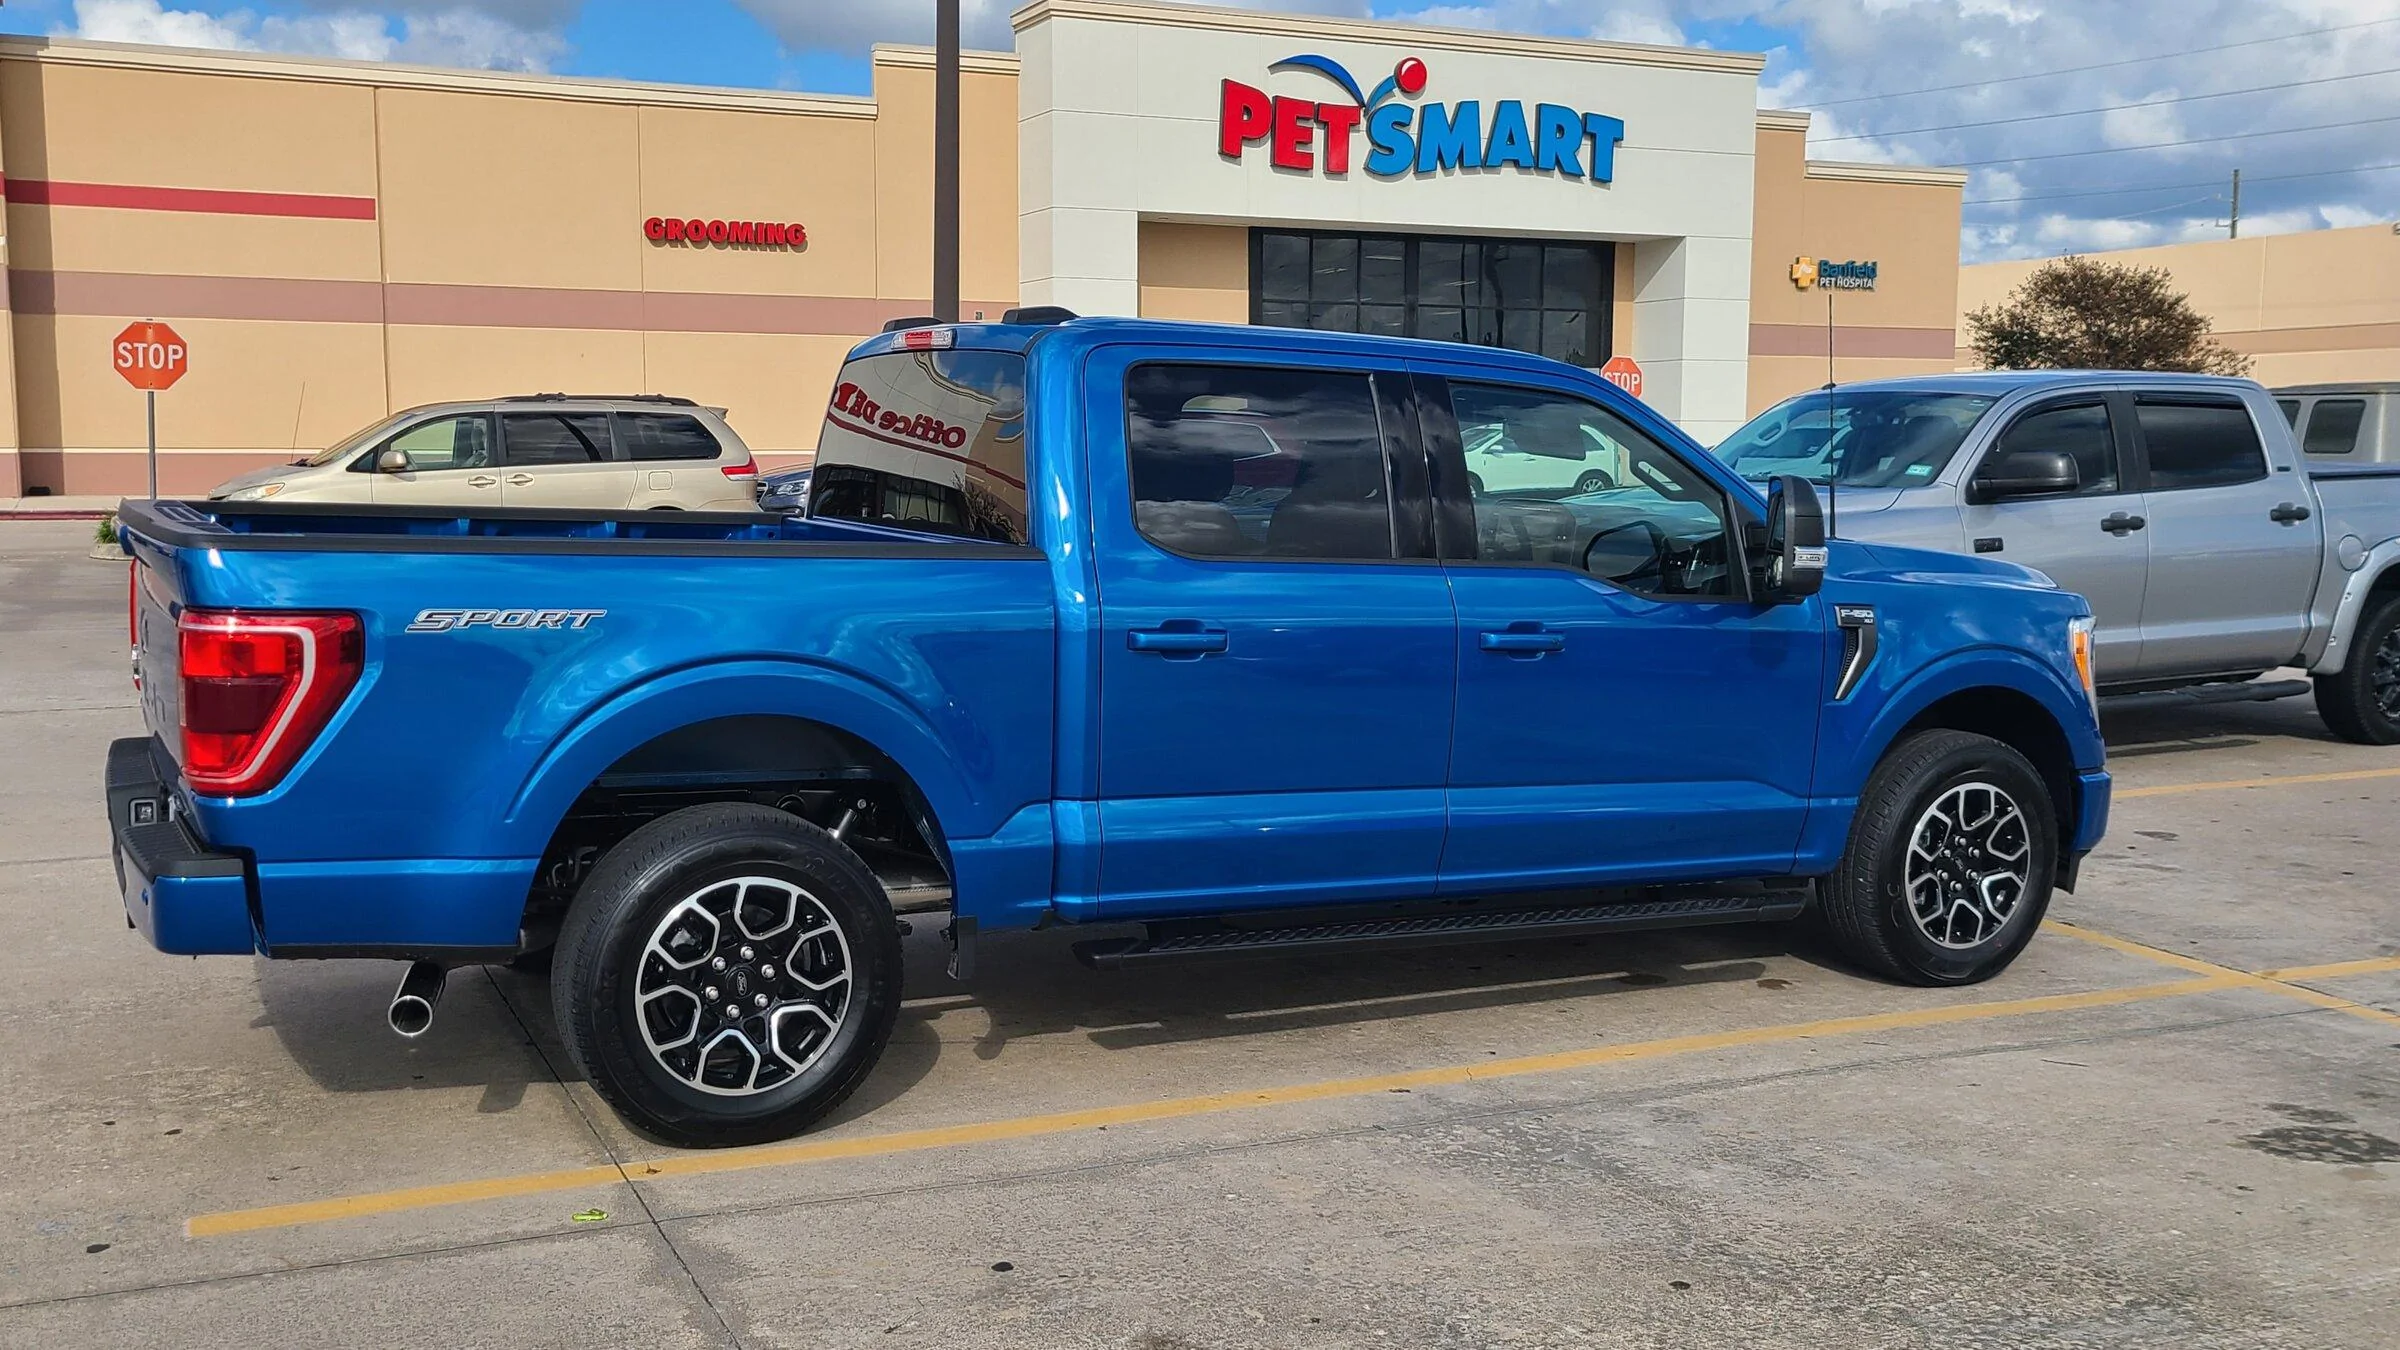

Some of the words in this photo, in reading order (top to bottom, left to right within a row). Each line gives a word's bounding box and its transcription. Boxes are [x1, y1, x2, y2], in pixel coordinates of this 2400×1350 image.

[1218, 78, 1624, 183] PETSMART
[643, 217, 807, 246] GROOMING
[1819, 259, 1877, 277] Banfield
[1820, 277, 1836, 288] PET
[117, 341, 184, 370] STOP
[405, 608, 608, 633] SPORT
[1840, 609, 1875, 618] F-150
